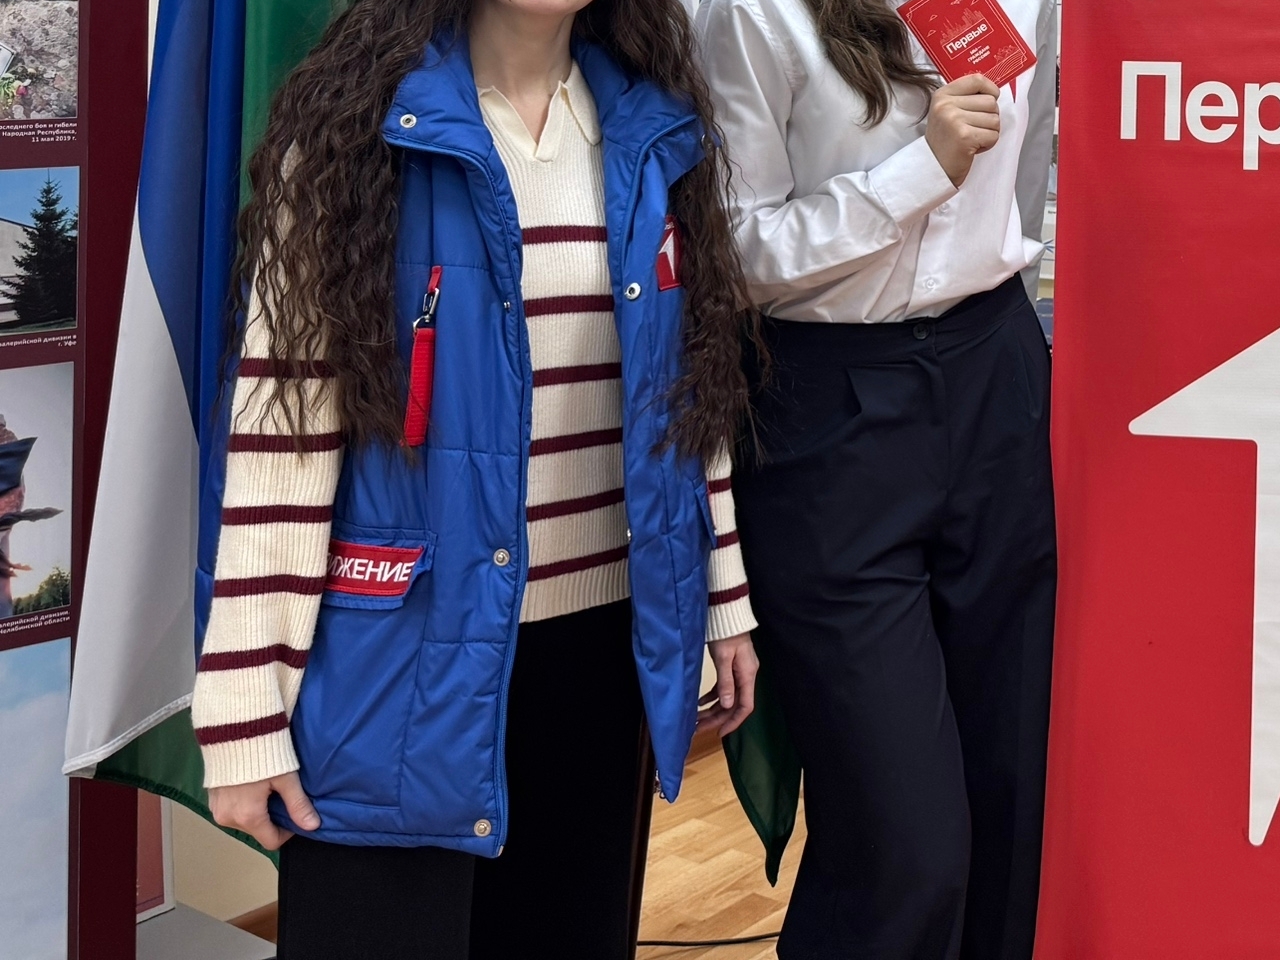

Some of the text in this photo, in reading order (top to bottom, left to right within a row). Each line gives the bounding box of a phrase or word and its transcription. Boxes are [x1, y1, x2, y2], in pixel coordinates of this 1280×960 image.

[946, 22, 988, 54] Первые
[2, 128, 77, 138] Народная Республика,
[327, 553, 416, 583] ИЖЕНИЕ
